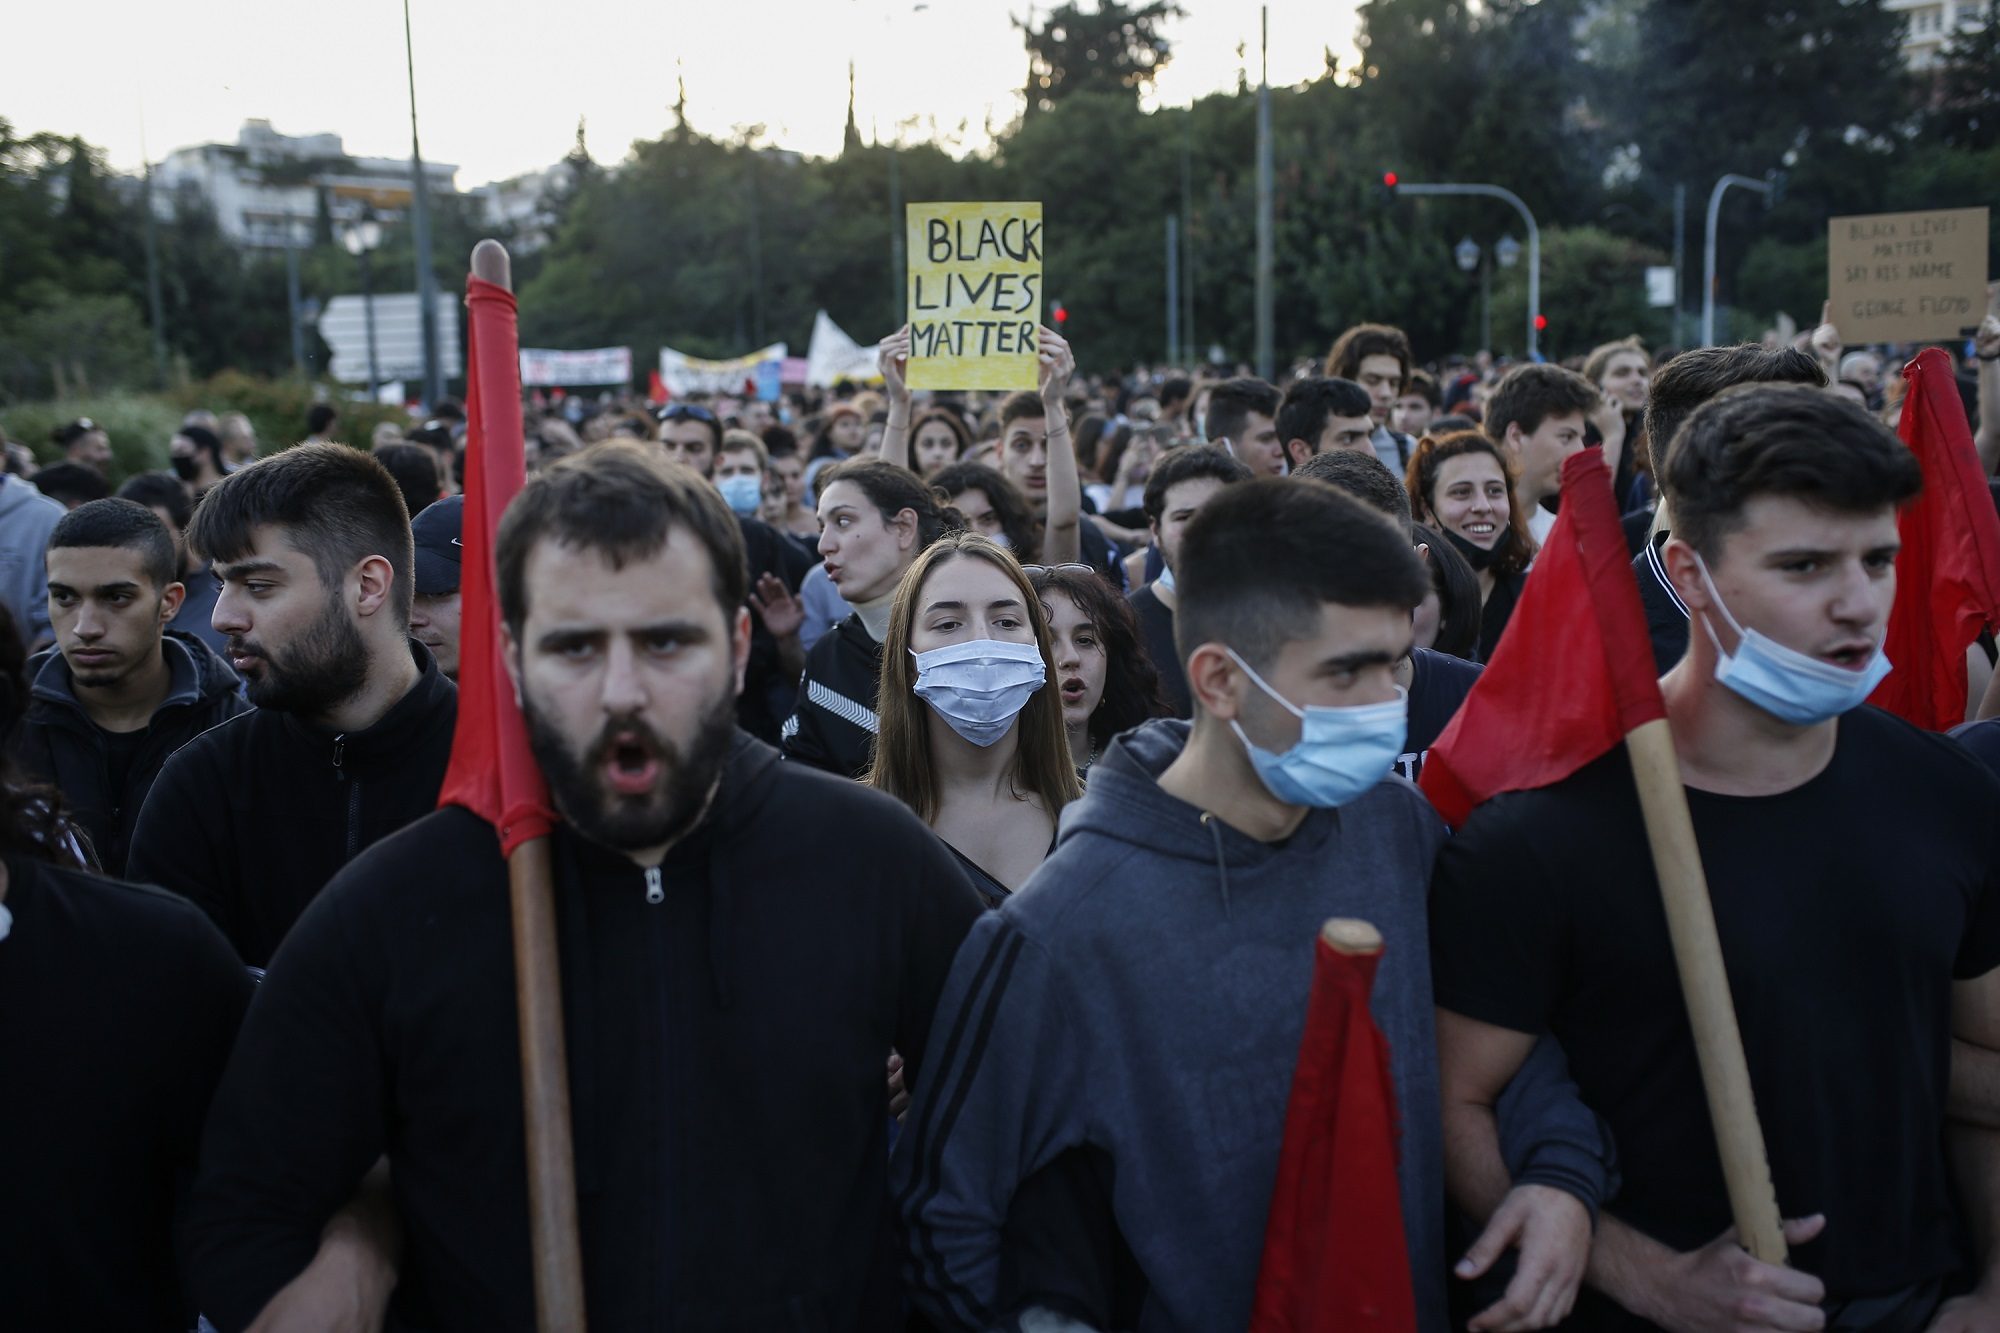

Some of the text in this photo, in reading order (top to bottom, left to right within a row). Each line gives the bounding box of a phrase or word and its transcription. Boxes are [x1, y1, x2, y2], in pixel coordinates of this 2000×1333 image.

[928, 218, 1041, 263] BLACK
[1849, 216, 1959, 241] BLACK LIVES
[1872, 239, 1934, 258] MATTER
[1845, 262, 1954, 283] SAY HIS NAME
[915, 272, 1040, 313] LIVES
[910, 321, 1036, 358] MATTER
